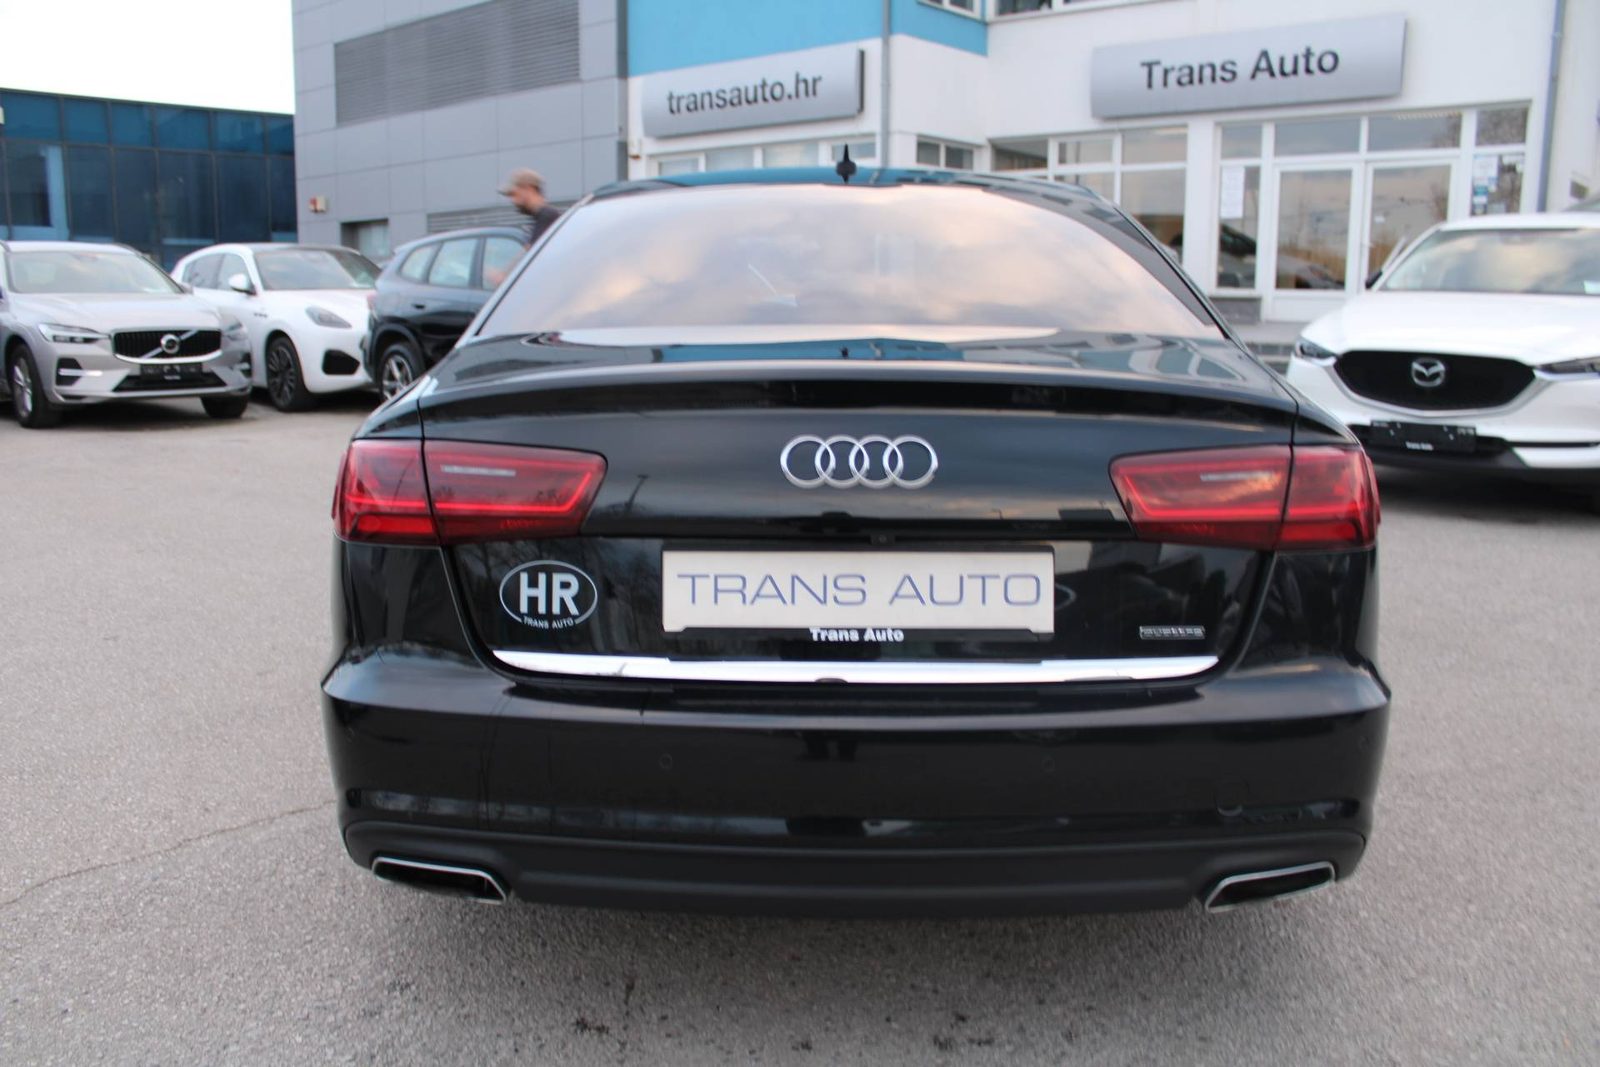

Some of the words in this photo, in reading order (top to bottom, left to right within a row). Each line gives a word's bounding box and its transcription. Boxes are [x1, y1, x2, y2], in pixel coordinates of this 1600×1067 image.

[1141, 60, 1238, 90] Trans
[1250, 46, 1340, 80] Auto
[667, 72, 822, 115] transauto.hr
[520, 572, 580, 616] HR
[677, 573, 867, 606] TRANS
[889, 573, 1042, 607] AUTO
[552, 617, 574, 629] AUTO
[809, 627, 859, 642] Trans
[863, 627, 904, 642] Auto
